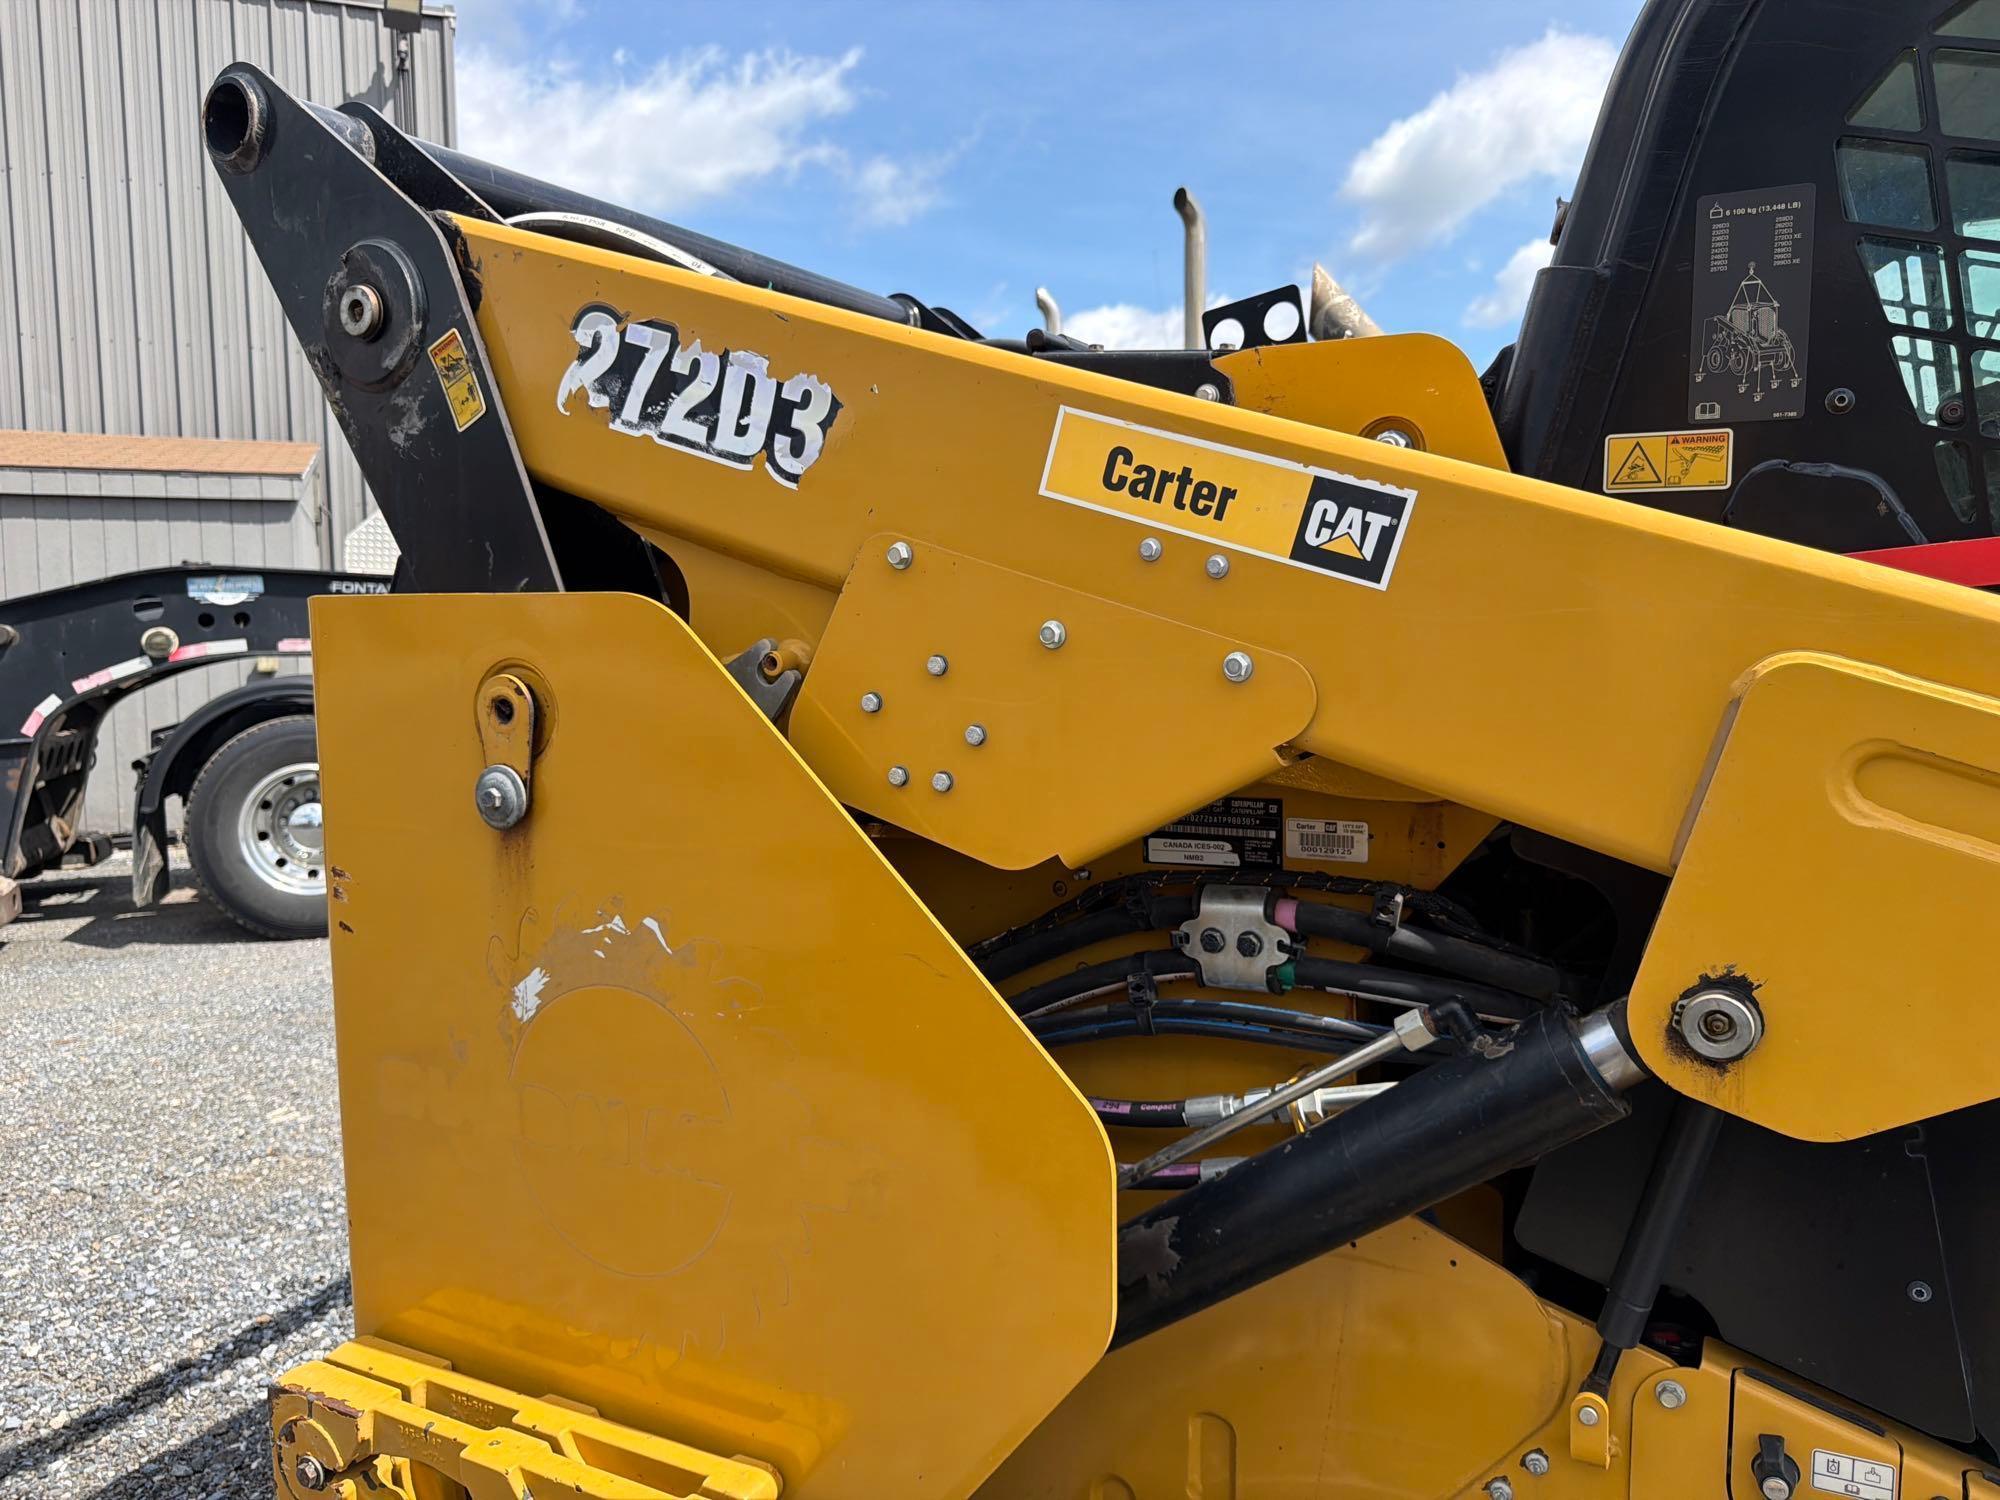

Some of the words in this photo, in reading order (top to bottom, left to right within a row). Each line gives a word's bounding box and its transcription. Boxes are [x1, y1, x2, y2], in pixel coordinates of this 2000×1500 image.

[1747, 207, 1757, 215] kg
[1787, 201, 1802, 209] LB)
[557, 310, 836, 478] 272D3
[1681, 434, 1726, 445] WARNING
[1102, 445, 1238, 523] Carter
[1296, 822, 1316, 830] Carter
[1163, 841, 1193, 849] CANADA
[1140, 1103, 1177, 1112] Compact
